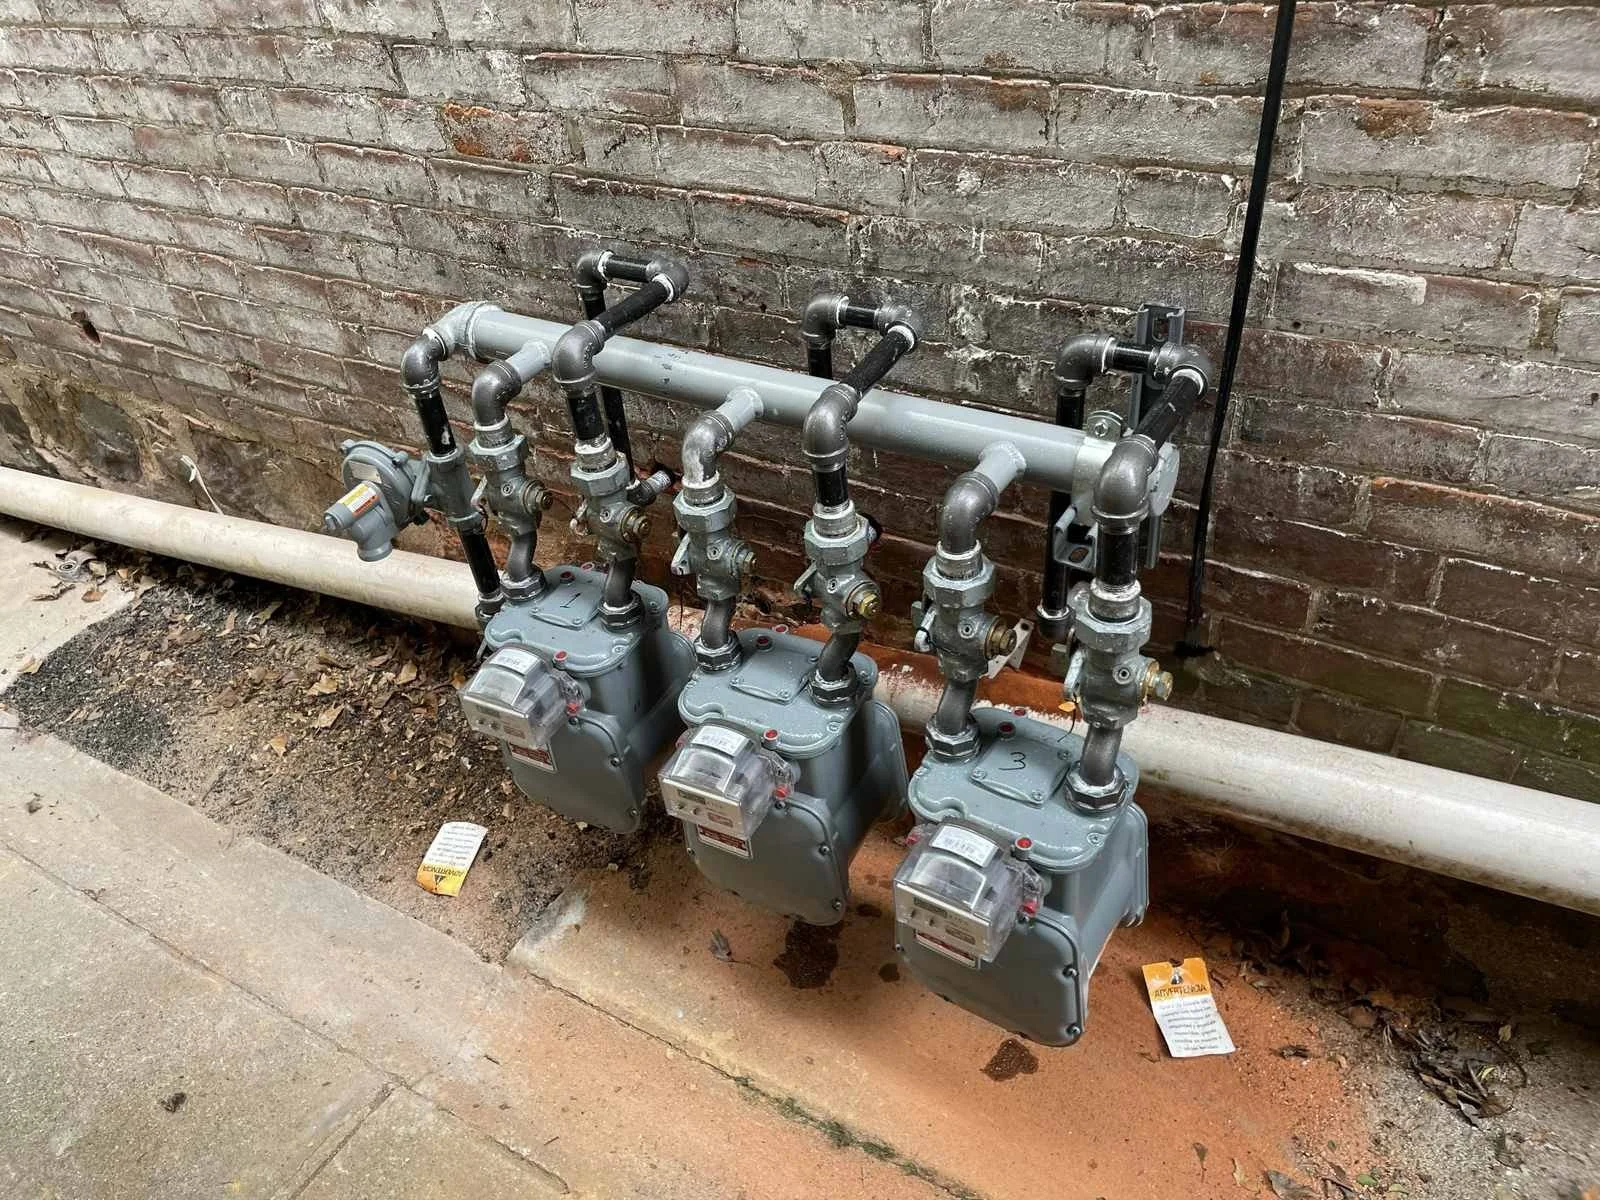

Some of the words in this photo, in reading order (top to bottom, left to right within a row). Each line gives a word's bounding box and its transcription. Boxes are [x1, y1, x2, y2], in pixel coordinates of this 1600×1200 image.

[559, 592, 582, 609] 1
[998, 751, 1026, 771] 3
[1154, 984, 1208, 997] ADVERTENCIA
